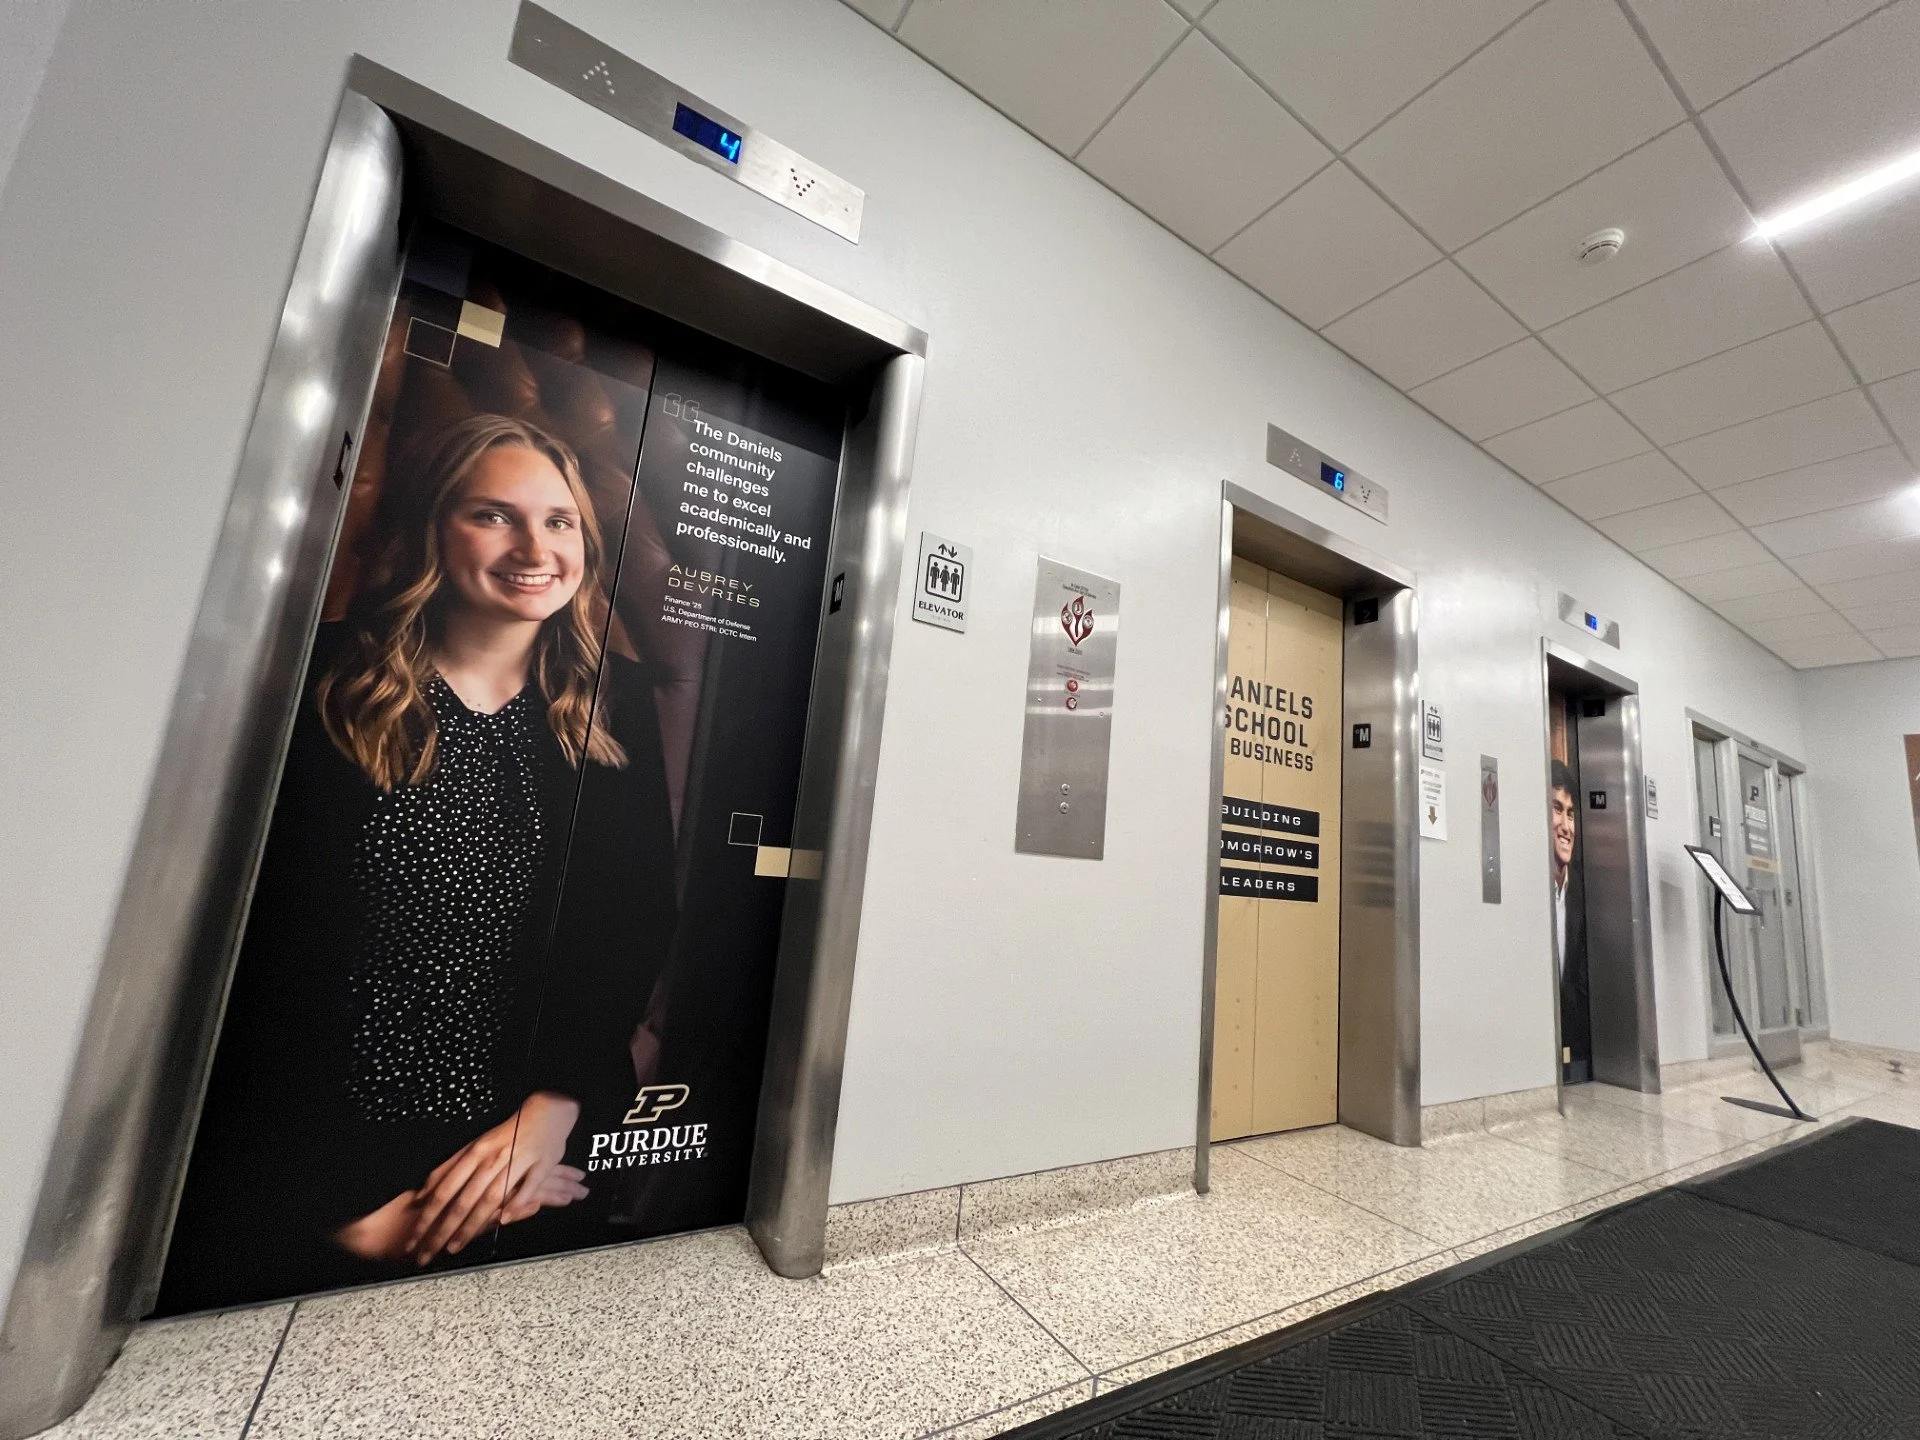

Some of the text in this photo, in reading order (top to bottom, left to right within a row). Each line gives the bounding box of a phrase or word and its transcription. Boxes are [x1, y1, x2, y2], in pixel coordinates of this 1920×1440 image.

[721, 133, 740, 160] 4
[694, 419, 783, 462] The Daniels
[690, 442, 776, 481] community
[686, 462, 770, 497] challenges
[1334, 472, 1344, 492] 6
[683, 481, 772, 518] me to excel
[680, 502, 811, 549] academically and
[676, 521, 787, 563] professionally.
[669, 564, 753, 591] AUBREY
[664, 595, 691, 607] Finance
[668, 577, 761, 608] DEVRIES
[663, 605, 676, 613] U.S.
[678, 608, 717, 623] Department
[725, 619, 751, 631] Defense
[918, 600, 964, 621] ELEVATOR
[661, 615, 684, 625] ARMY
[719, 627, 738, 637] DCTC
[1359, 728, 1369, 741] M
[1230, 737, 1313, 772] BUSINESS
[1221, 804, 1301, 826] BUILDING
[1221, 876, 1296, 892] LEADERS
[622, 1084, 690, 1125] P
[588, 1123, 708, 1158] PURDUE
[587, 1147, 706, 1172] UNIVERSITY
